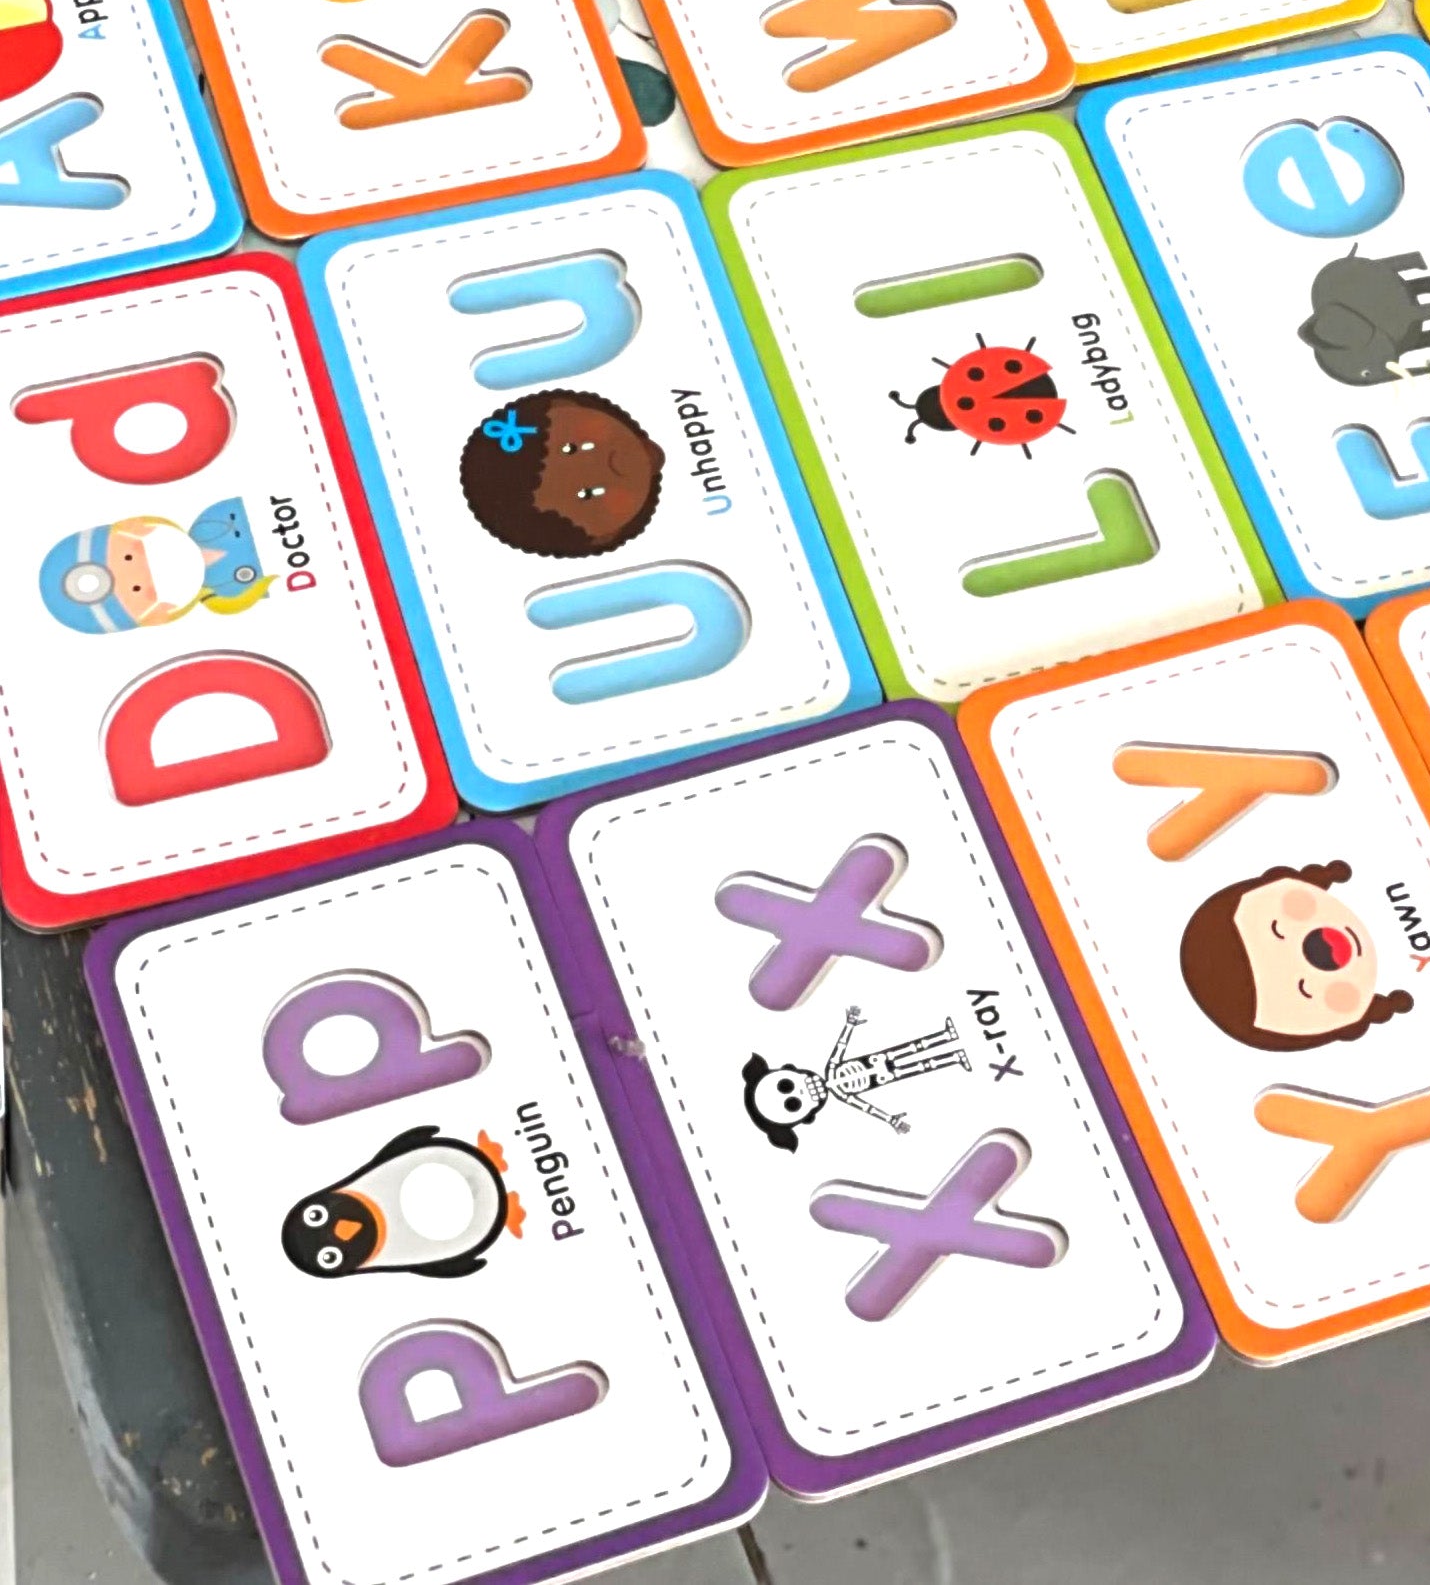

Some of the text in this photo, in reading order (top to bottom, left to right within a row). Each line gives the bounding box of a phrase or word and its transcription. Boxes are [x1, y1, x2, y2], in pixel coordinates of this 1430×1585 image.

[0, 92, 131, 210] A
[1240, 115, 1405, 239] e
[1071, 313, 1137, 424] Ladybug
[670, 388, 733, 517] Unhappy
[9, 351, 334, 807] D d
[269, 495, 318, 593] Doctor
[958, 467, 1160, 598] L
[523, 558, 753, 706] U
[966, 987, 1025, 1083] X-ray
[514, 1100, 586, 1242] Penguin
